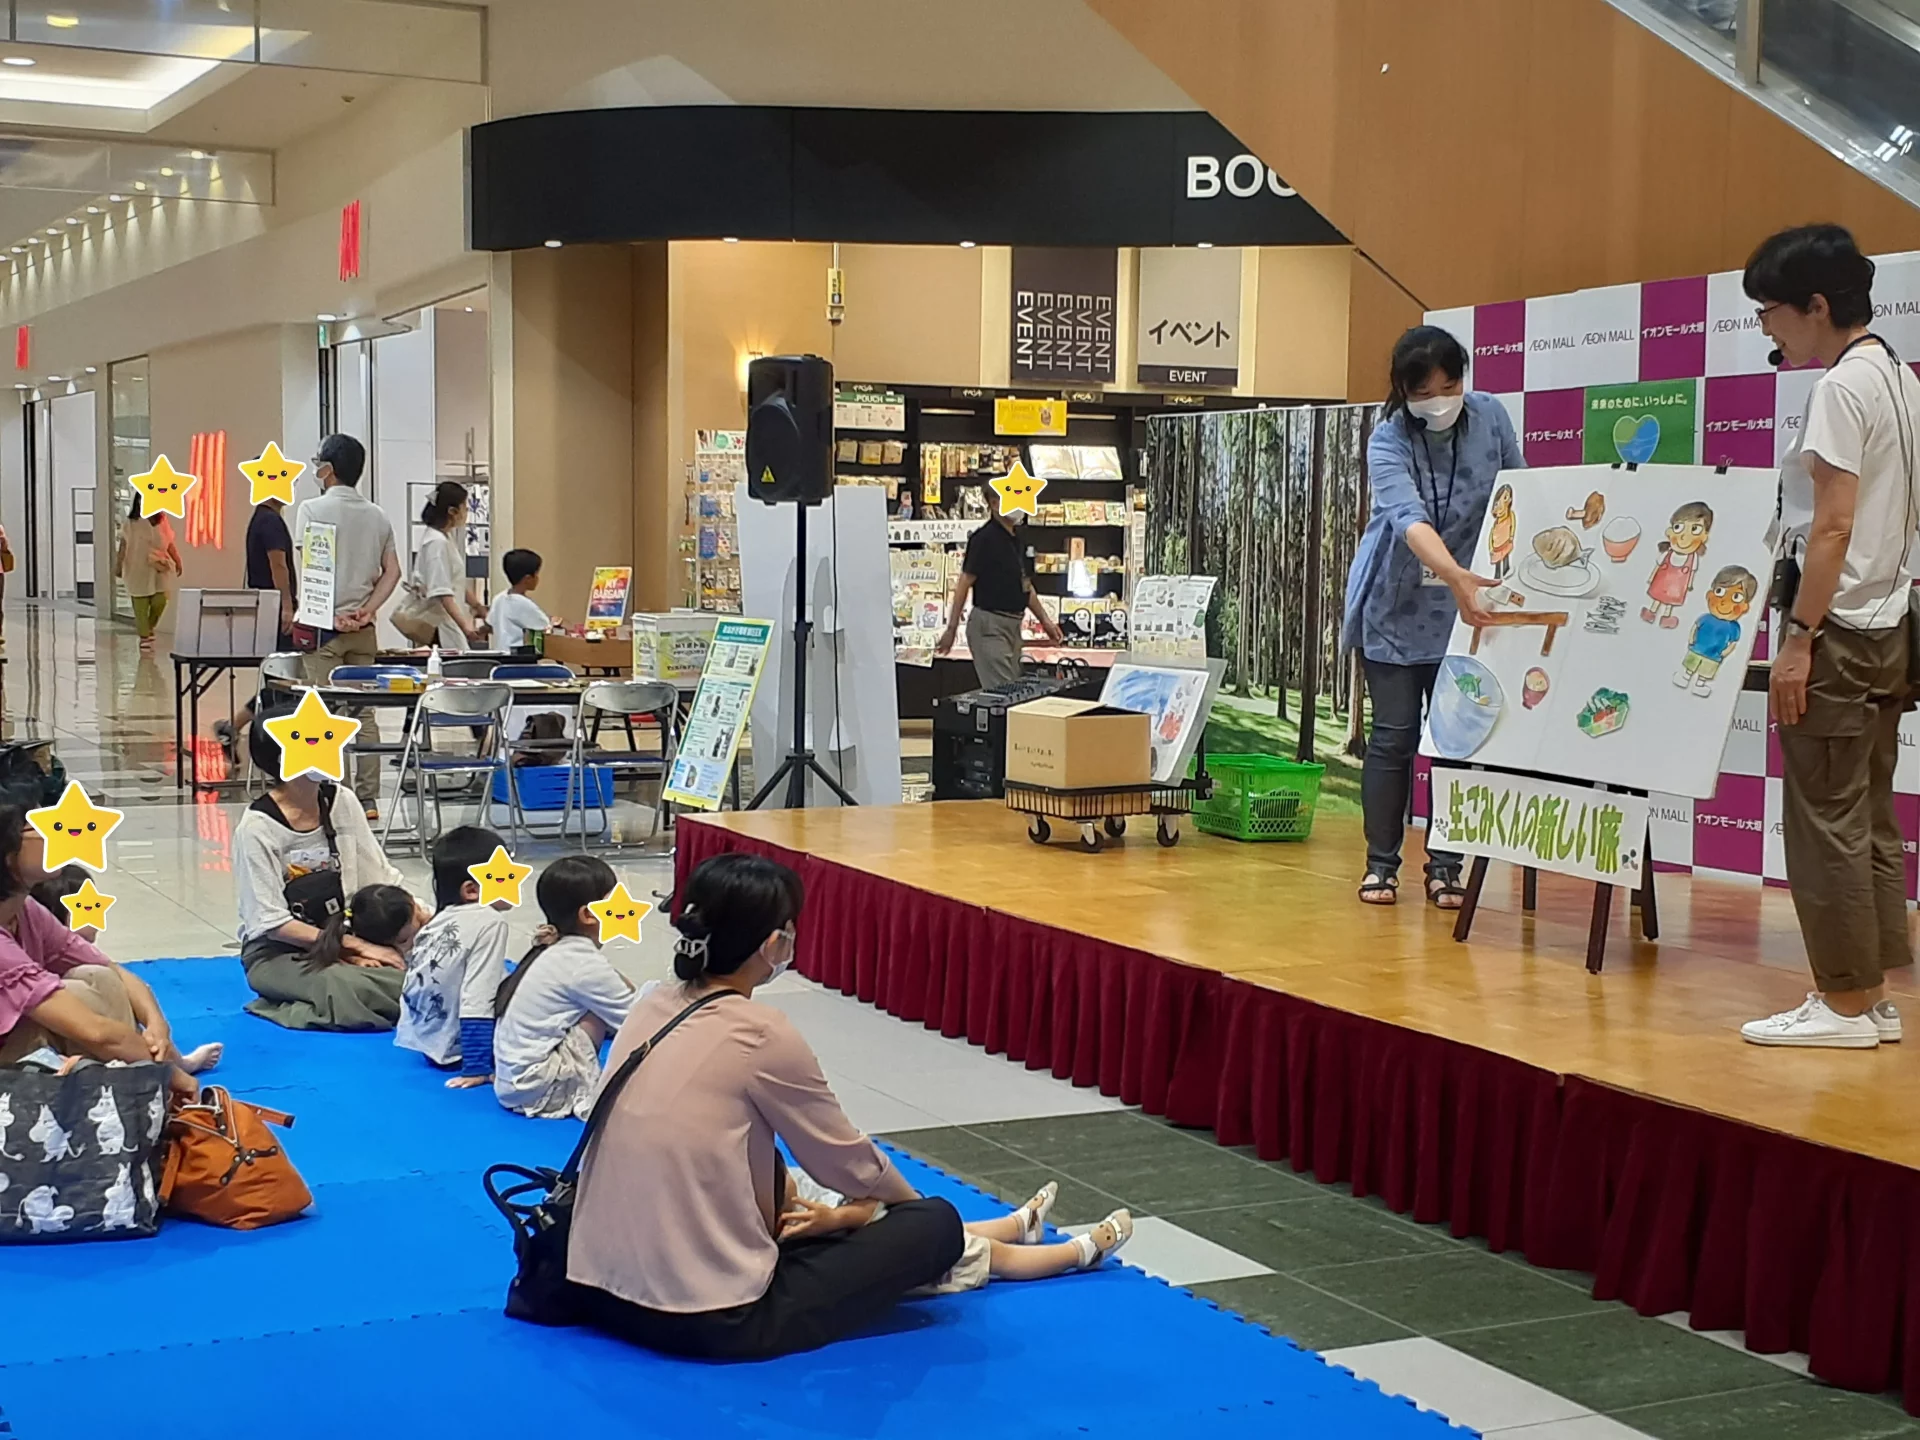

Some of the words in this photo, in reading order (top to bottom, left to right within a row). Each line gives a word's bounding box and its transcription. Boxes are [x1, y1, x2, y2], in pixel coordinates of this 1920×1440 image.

[1017, 291, 1033, 370] EVENT
[1037, 293, 1053, 370] EVENT
[1056, 294, 1073, 371] EVENT
[1076, 295, 1092, 373] EVENT
[1095, 296, 1111, 373] EVENT
[1149, 319, 1230, 348] イベント
[1609, 329, 1635, 342] MALL
[1553, 336, 1575, 349] MALL
[1169, 370, 1207, 382] EVENT
[1706, 417, 1773, 432] イオンモール大垣
[1524, 428, 1573, 441] イオンモール大
[1661, 807, 1688, 823] MALL
[1696, 813, 1762, 832] イオンモール大垣
